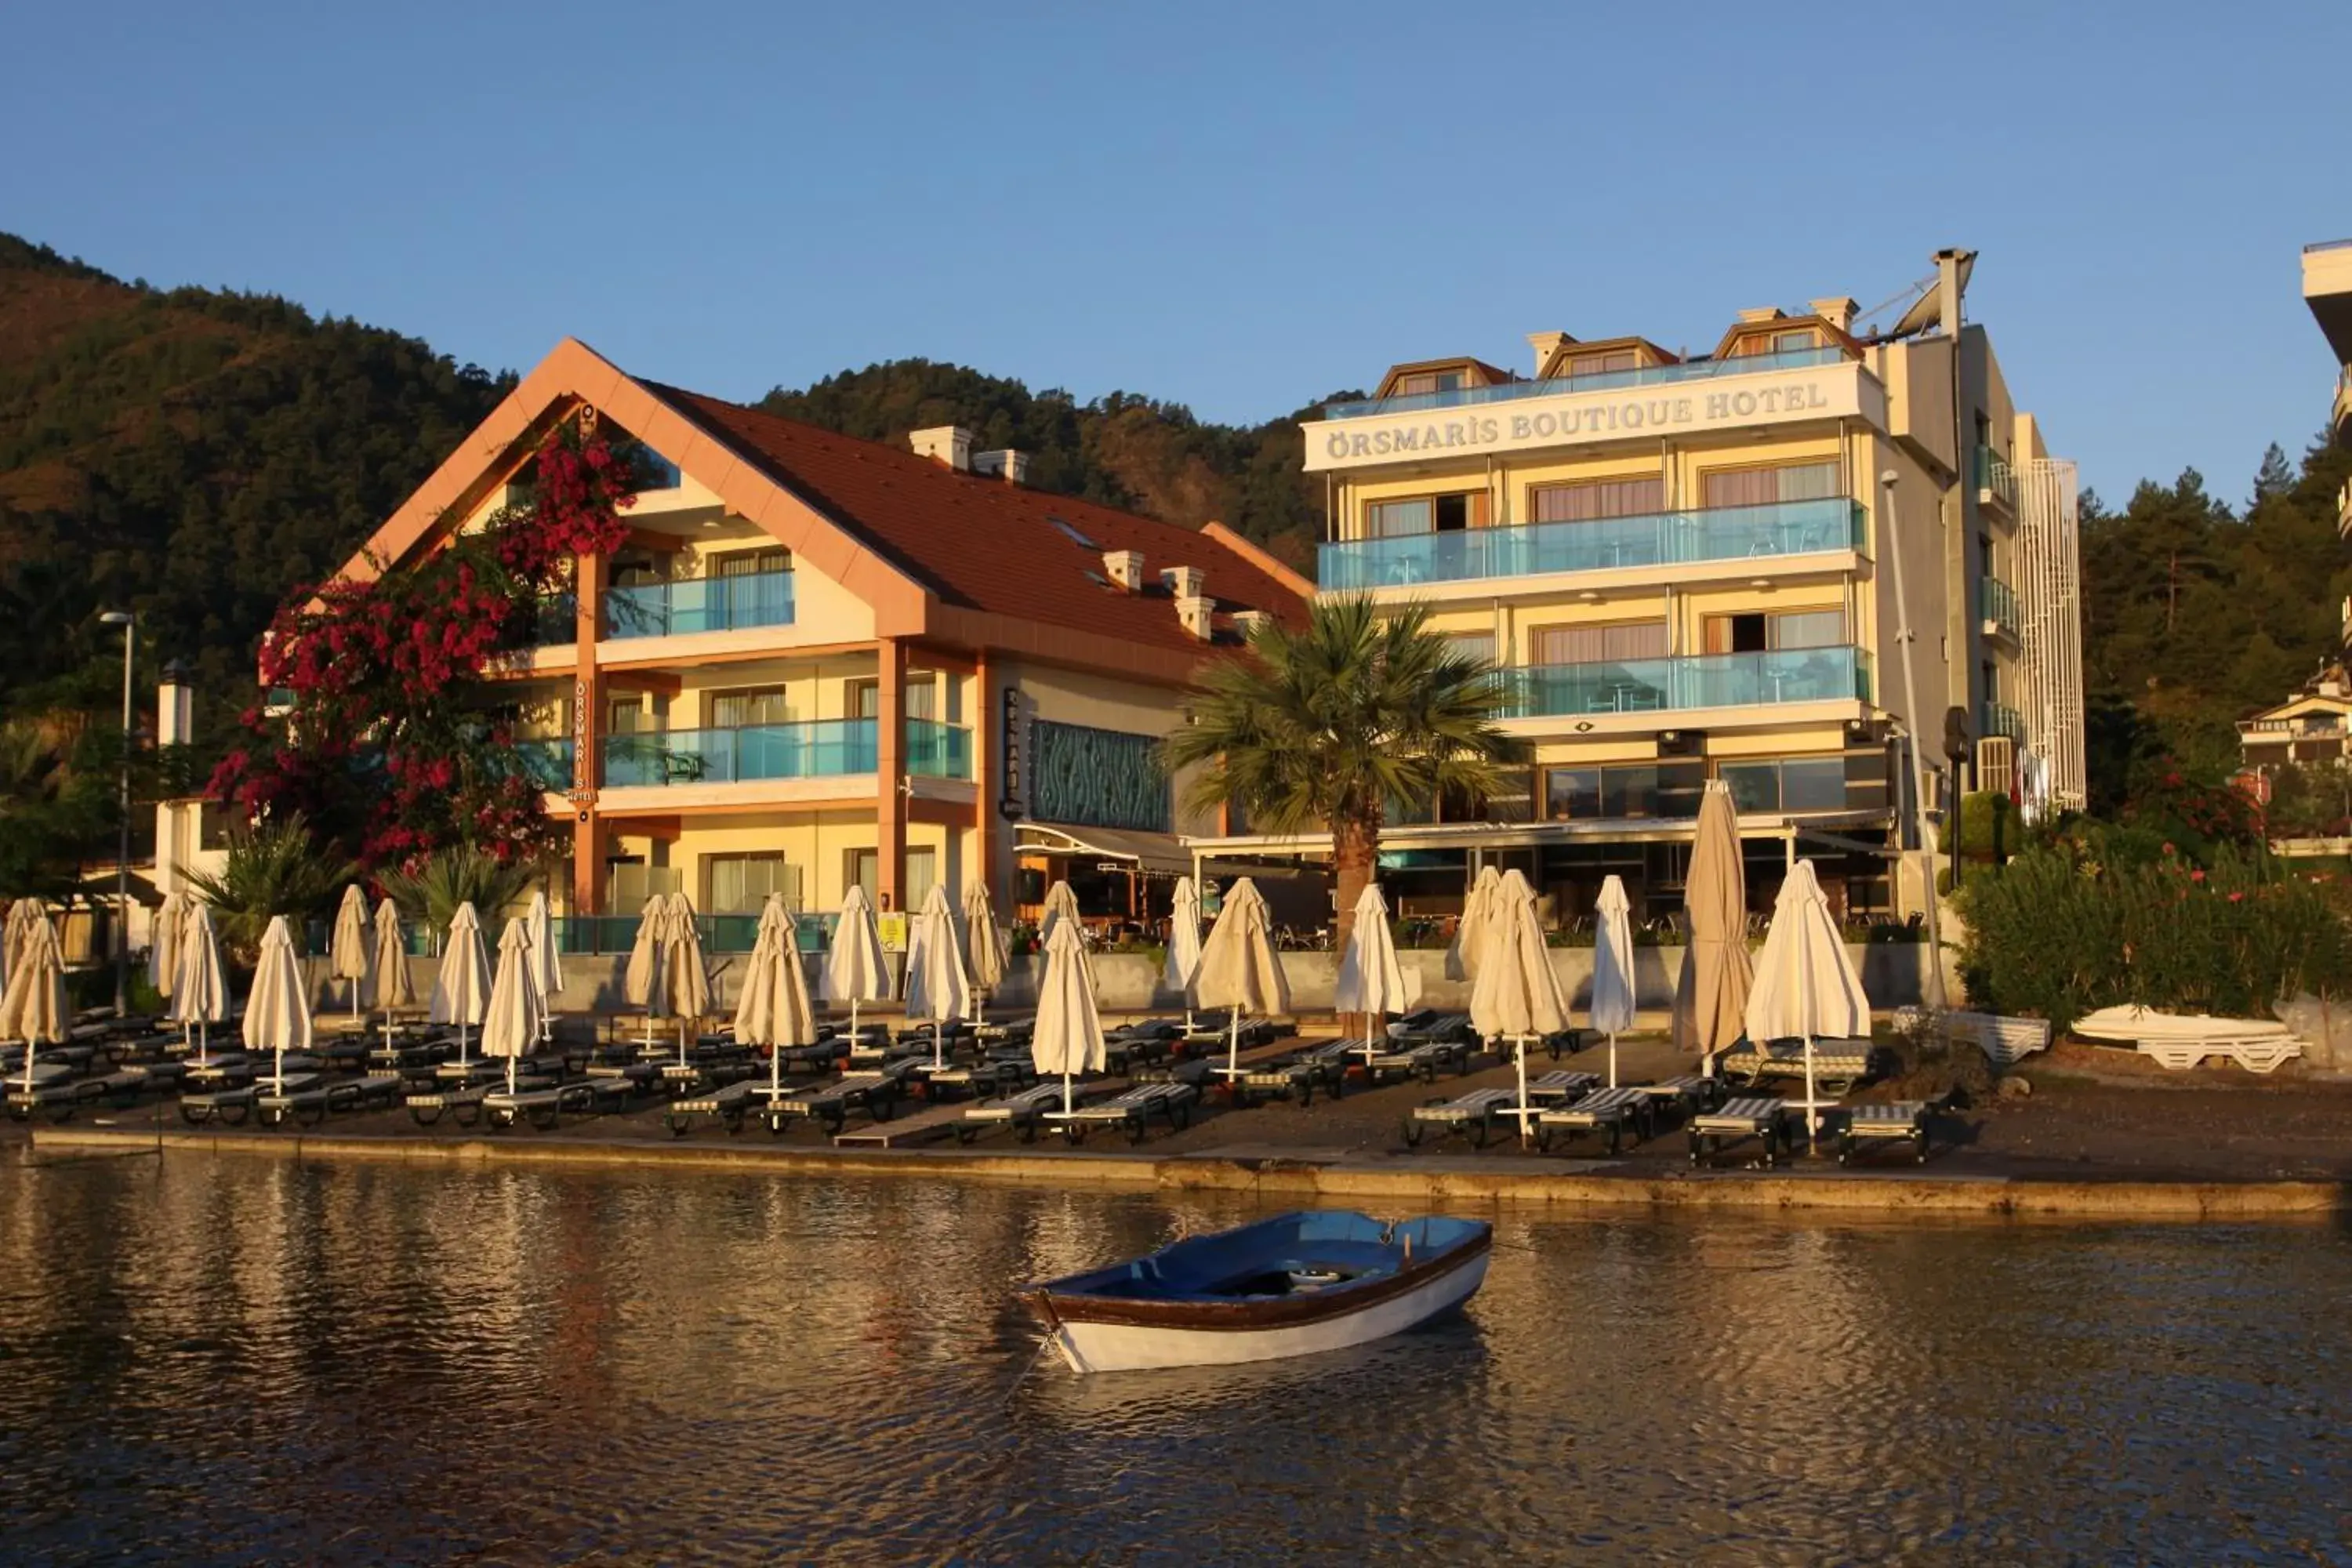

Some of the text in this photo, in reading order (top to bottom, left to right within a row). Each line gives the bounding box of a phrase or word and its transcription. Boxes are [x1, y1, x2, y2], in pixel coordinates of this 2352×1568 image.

[1327, 383, 1828, 459] ÖRSMARİS BOUTIQUE HOTEL
